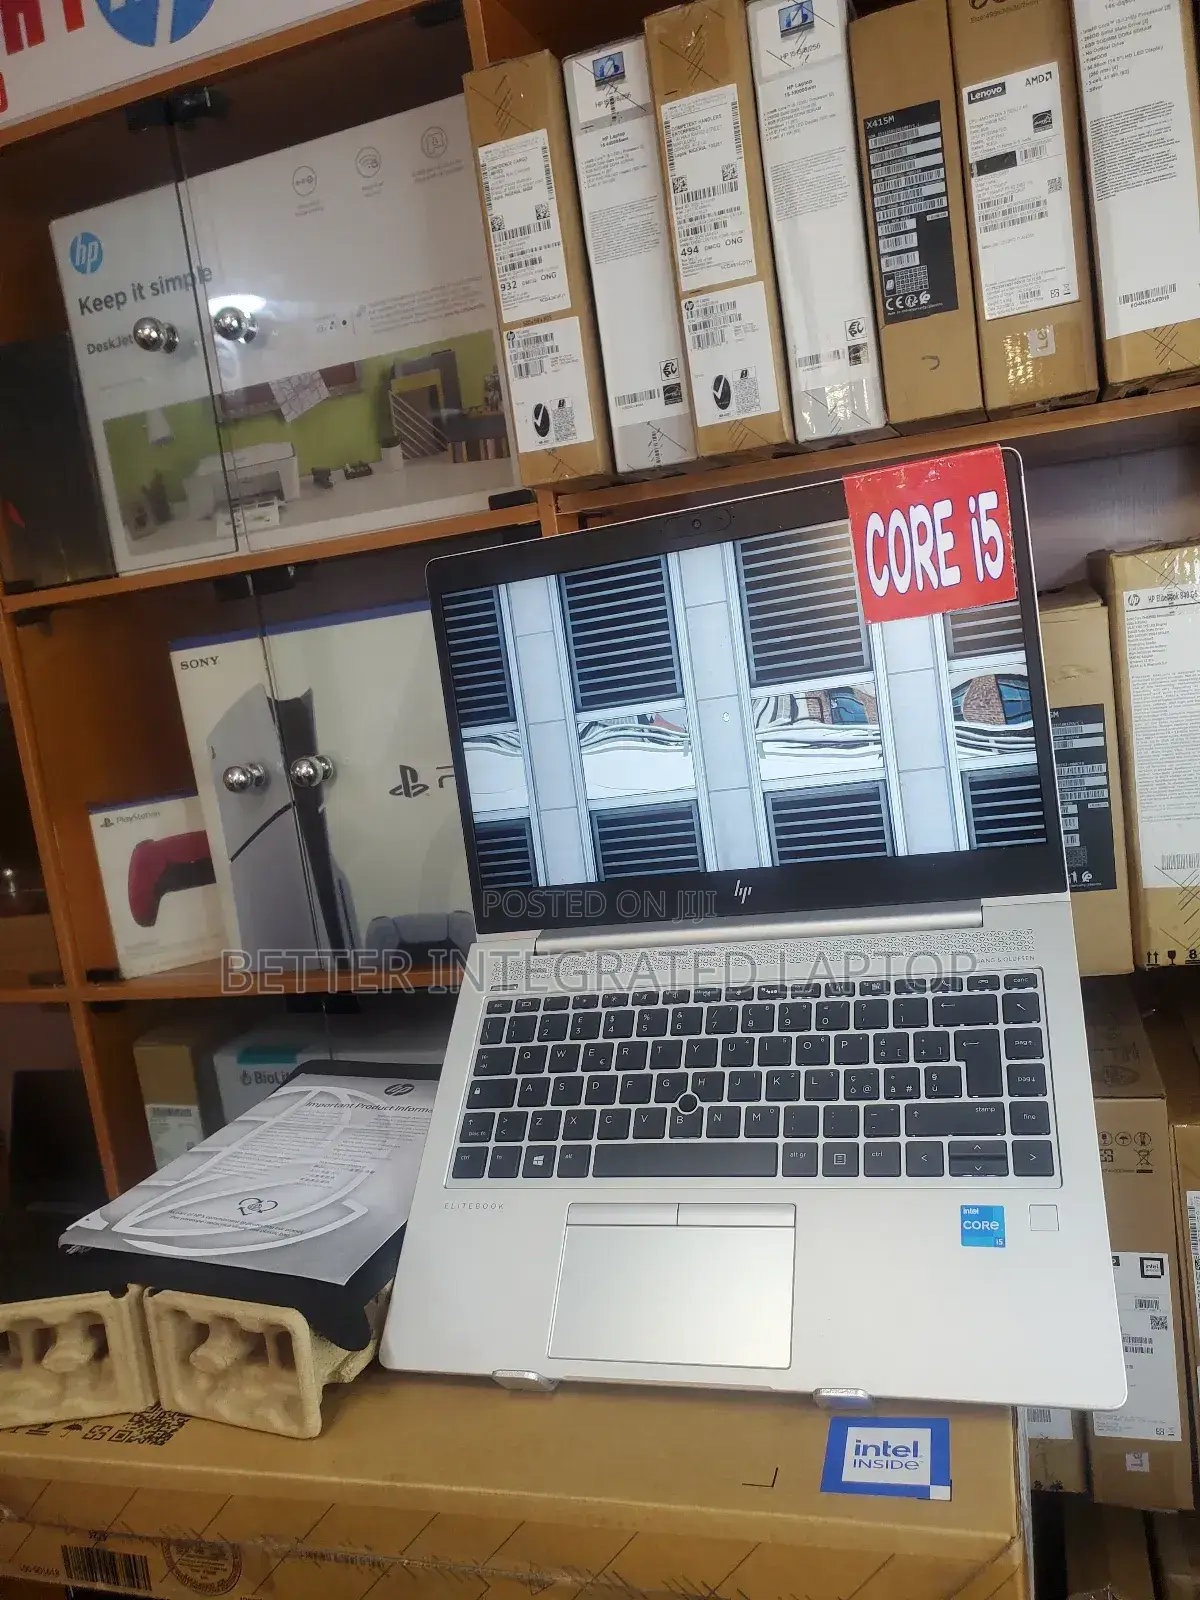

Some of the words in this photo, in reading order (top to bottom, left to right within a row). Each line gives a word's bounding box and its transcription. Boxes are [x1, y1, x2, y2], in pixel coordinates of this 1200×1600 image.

[970, 86, 1002, 101] Lenovo
[1025, 74, 1044, 87] AMD
[866, 115, 895, 129] X415M
[76, 232, 99, 274] hp
[681, 246, 699, 256] 494
[725, 237, 743, 246] ONG
[78, 290, 127, 316] Keep
[131, 283, 146, 302] it
[150, 265, 212, 296] simple
[501, 281, 517, 291] 932
[541, 272, 557, 280] ONG
[86, 334, 134, 355] DeskJet
[866, 499, 961, 597] CORE
[968, 490, 1005, 582] i5
[180, 656, 220, 670] SONY
[116, 811, 161, 825] PlayStation
[863, 1085, 872, 1093] @
[854, 1440, 918, 1458] intel
